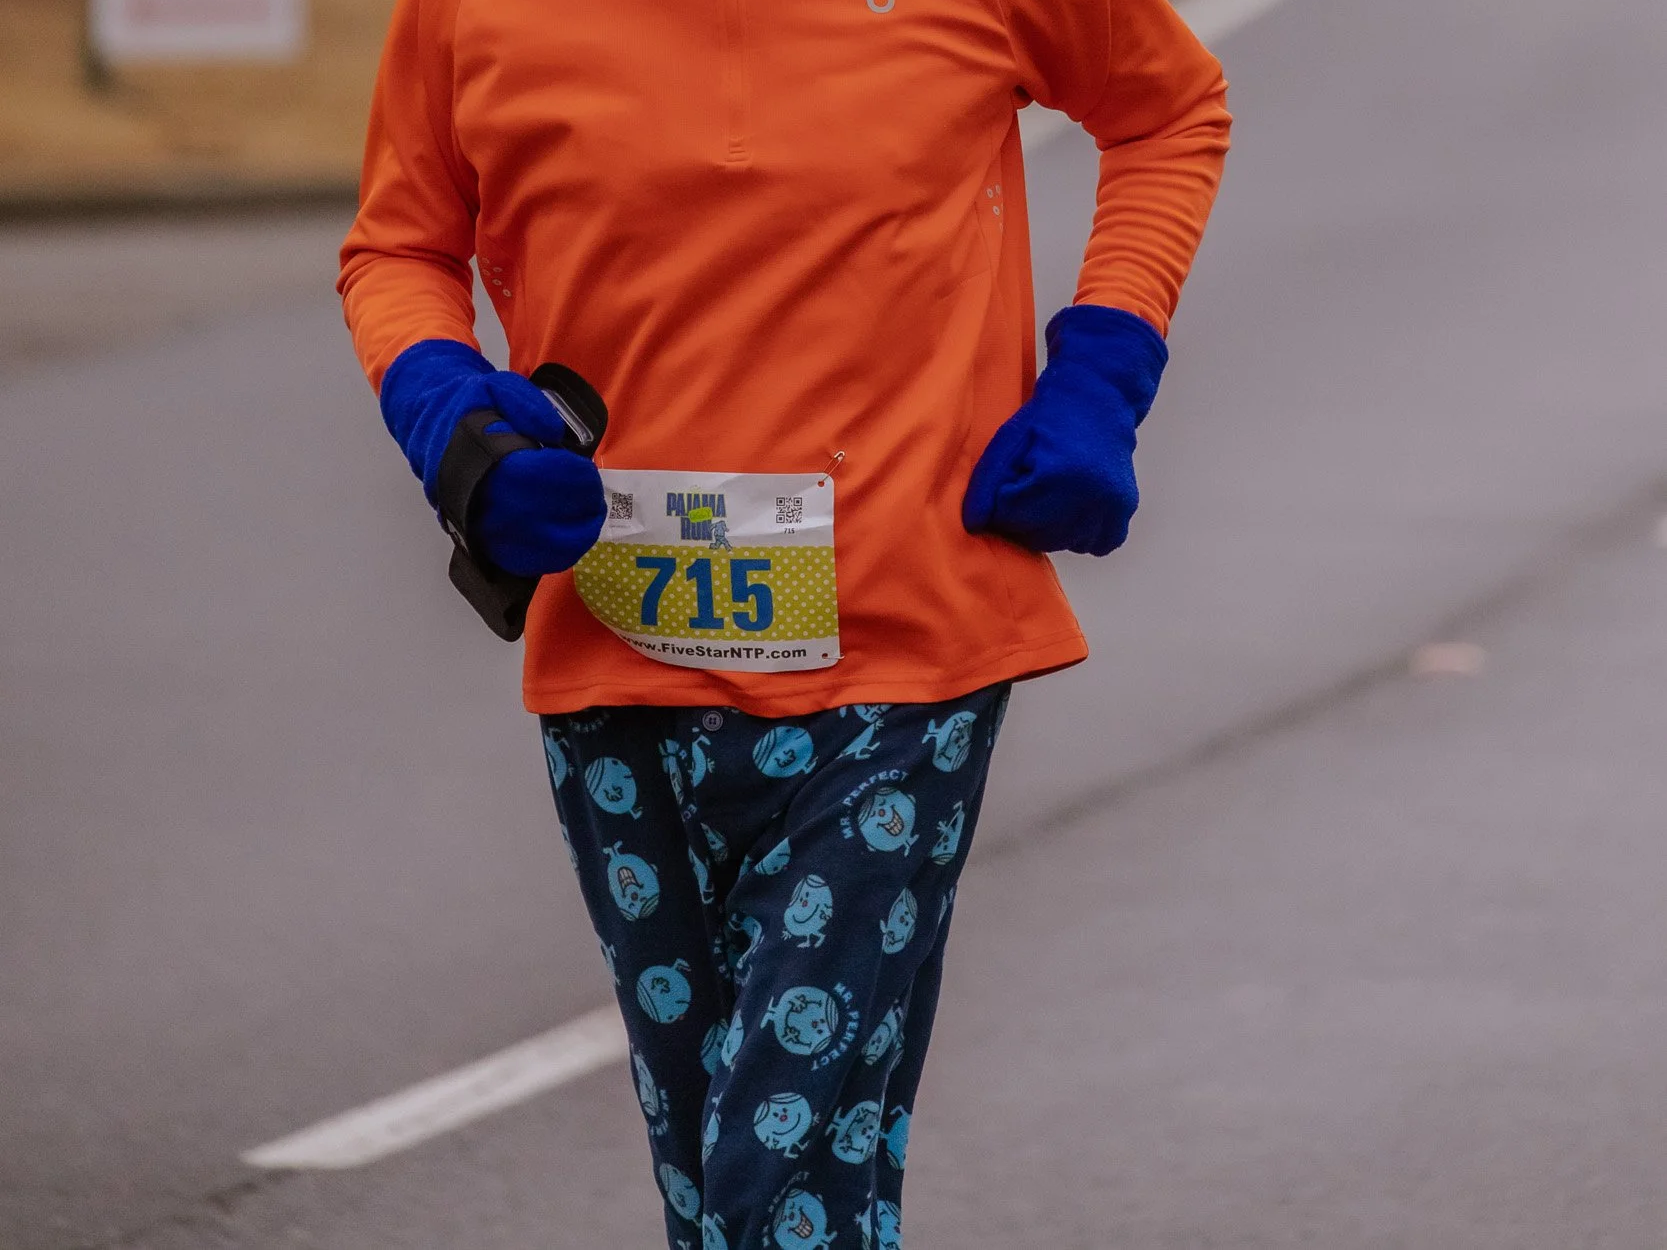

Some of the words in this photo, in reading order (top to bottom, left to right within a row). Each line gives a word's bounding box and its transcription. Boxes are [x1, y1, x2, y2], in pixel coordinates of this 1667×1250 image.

[666, 492, 726, 517] PAJAMA
[681, 517, 713, 541] RUN
[635, 556, 774, 631] 715
[842, 769, 908, 806] PERFECT
[811, 1010, 859, 1071] PERFECT
